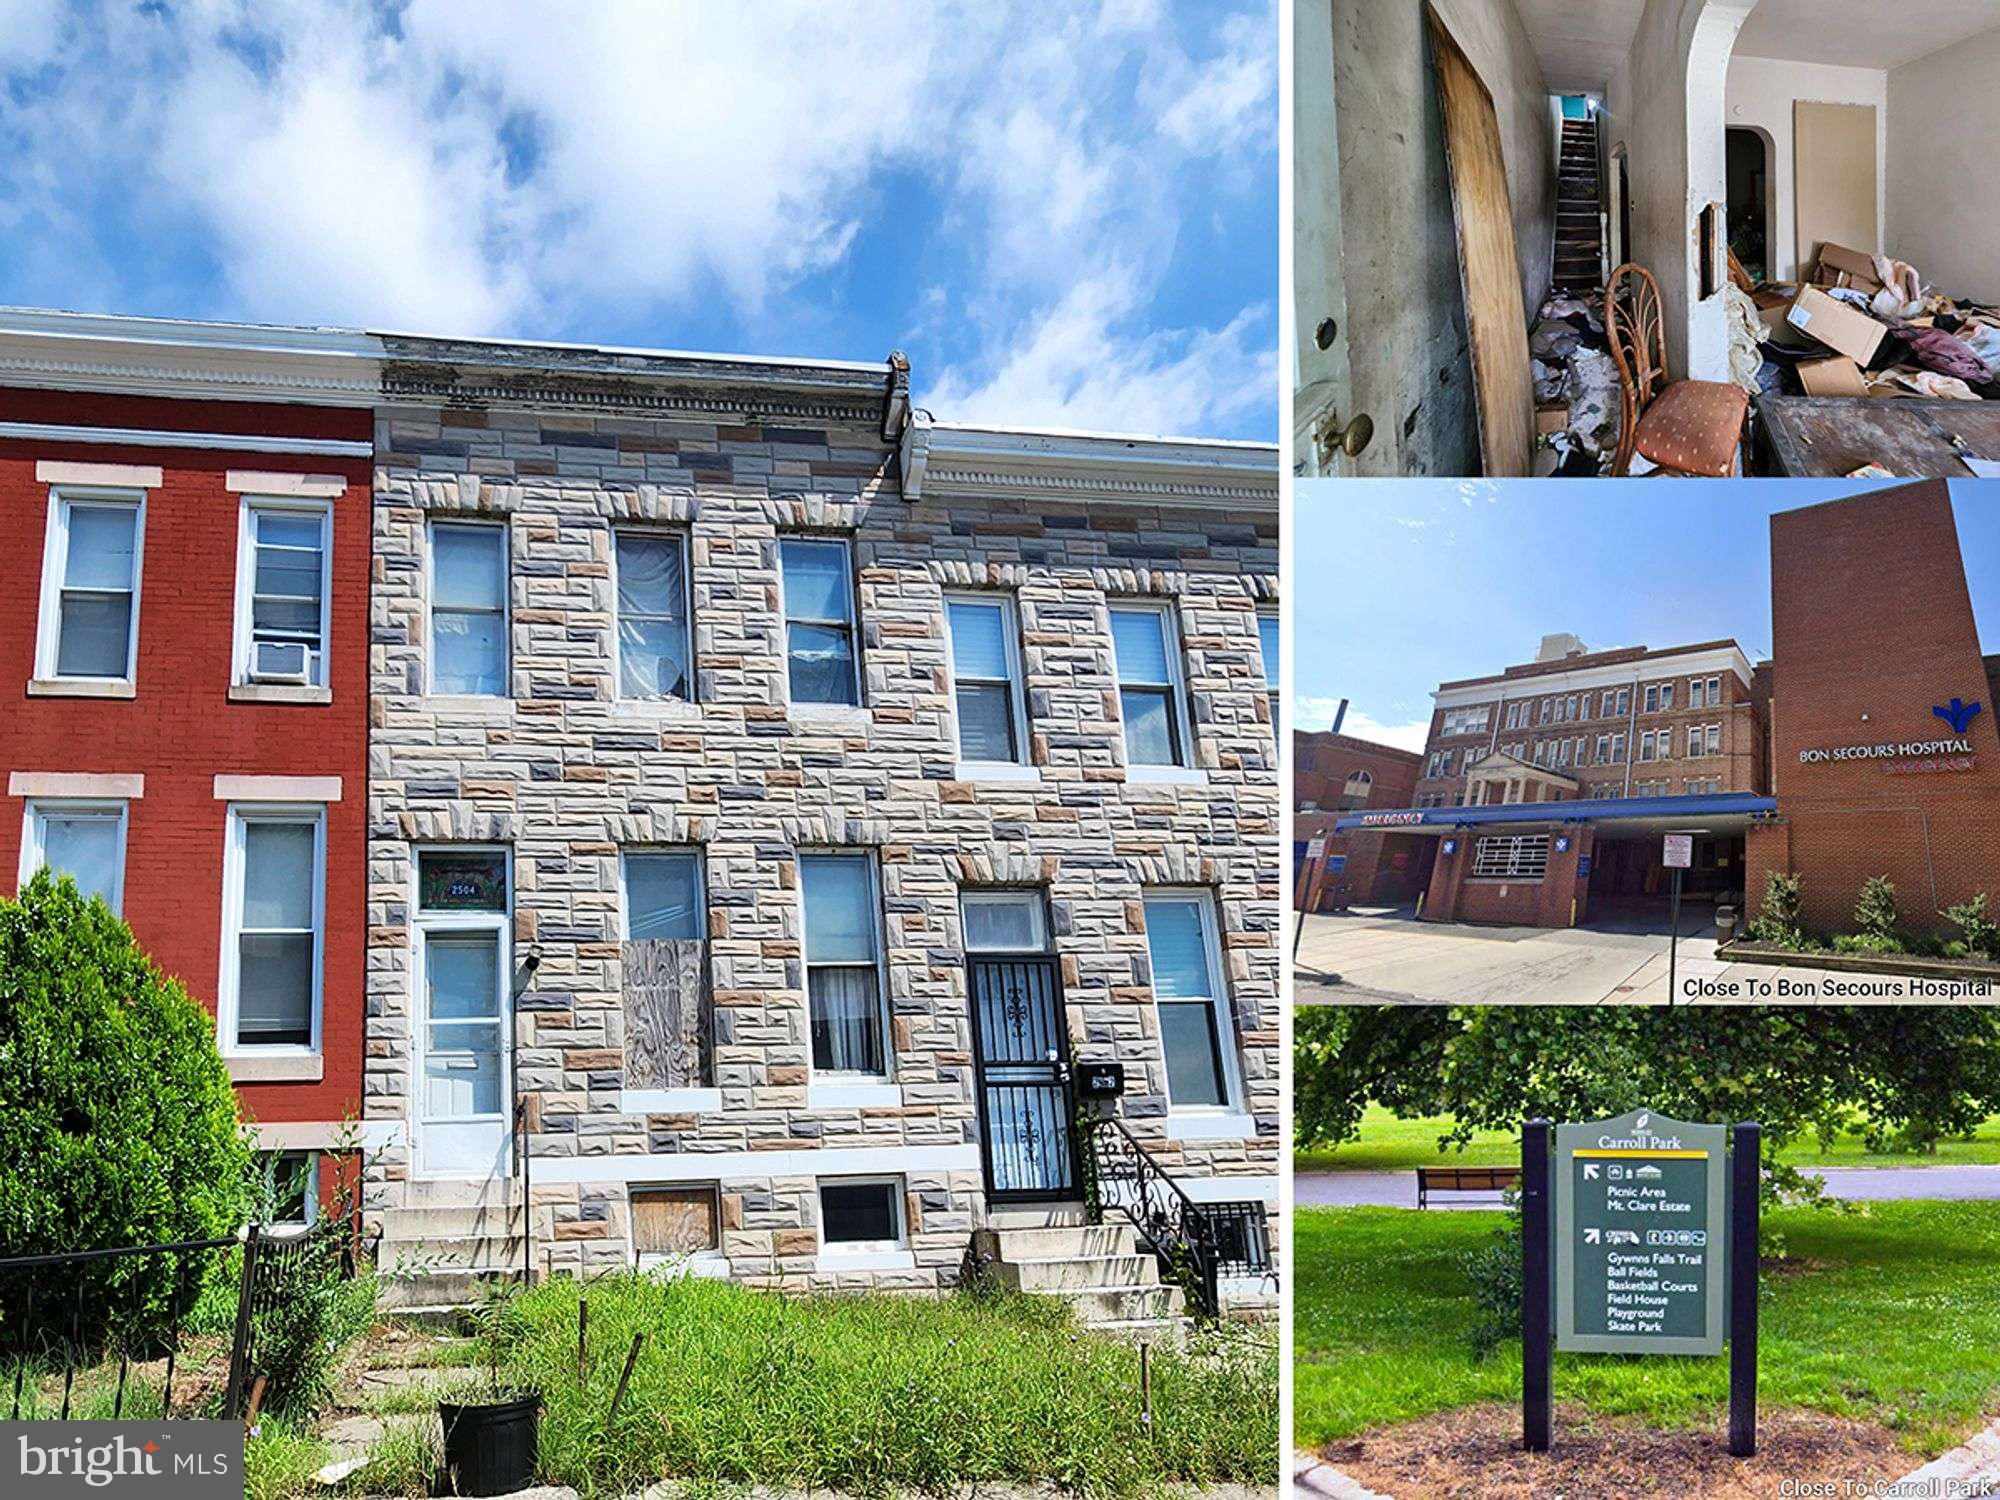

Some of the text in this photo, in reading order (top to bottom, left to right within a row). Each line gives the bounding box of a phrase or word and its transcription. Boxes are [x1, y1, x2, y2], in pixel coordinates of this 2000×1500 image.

[1800, 740, 1972, 763] BON SECOURS HOSPITAL
[451, 884, 475, 896] 2504
[1598, 1135, 1682, 1149] Carroll Park
[1607, 1186, 1666, 1197] Picnic Area
[1627, 1200, 1656, 1211] Clare
[1659, 1200, 1691, 1212] Estate
[1652, 1253, 1675, 1264] Falls
[1677, 1253, 1702, 1264] Trail
[1607, 1266, 1658, 1277] Ball Fields
[1607, 1279, 1698, 1292] Basketball Courts
[1607, 1293, 1669, 1305] Field House
[1607, 1306, 1665, 1320] Playground
[1607, 1320, 1663, 1332] Skate Park
